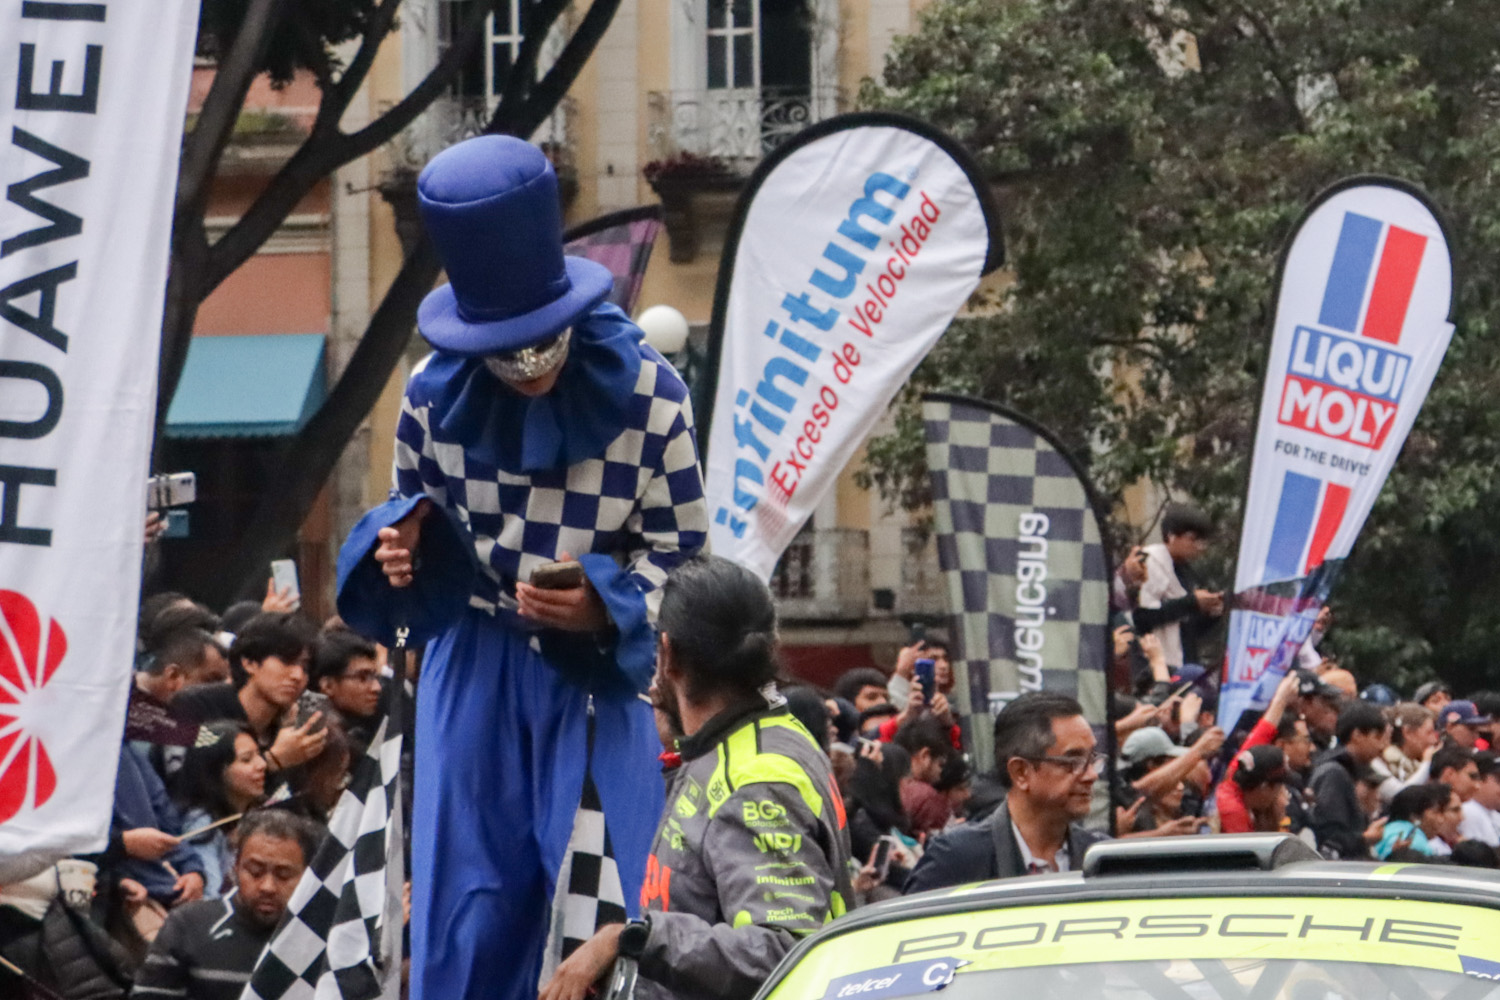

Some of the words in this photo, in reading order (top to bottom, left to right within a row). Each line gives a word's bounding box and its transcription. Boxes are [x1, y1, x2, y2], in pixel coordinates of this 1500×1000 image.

[0, 0, 107, 548] HUAWEI
[715, 171, 911, 539] infinitum
[770, 384, 839, 498] Exceso
[831, 340, 862, 385] de
[848, 190, 942, 339] Velocidad
[1291, 329, 1409, 400] LIQUI
[1280, 378, 1396, 445] MOLY
[1274, 439, 1301, 457] FOR
[1303, 447, 1327, 465] THE
[756, 875, 816, 887] infinitum
[891, 913, 1463, 964] PORSCHE
[836, 972, 903, 999] telcel
